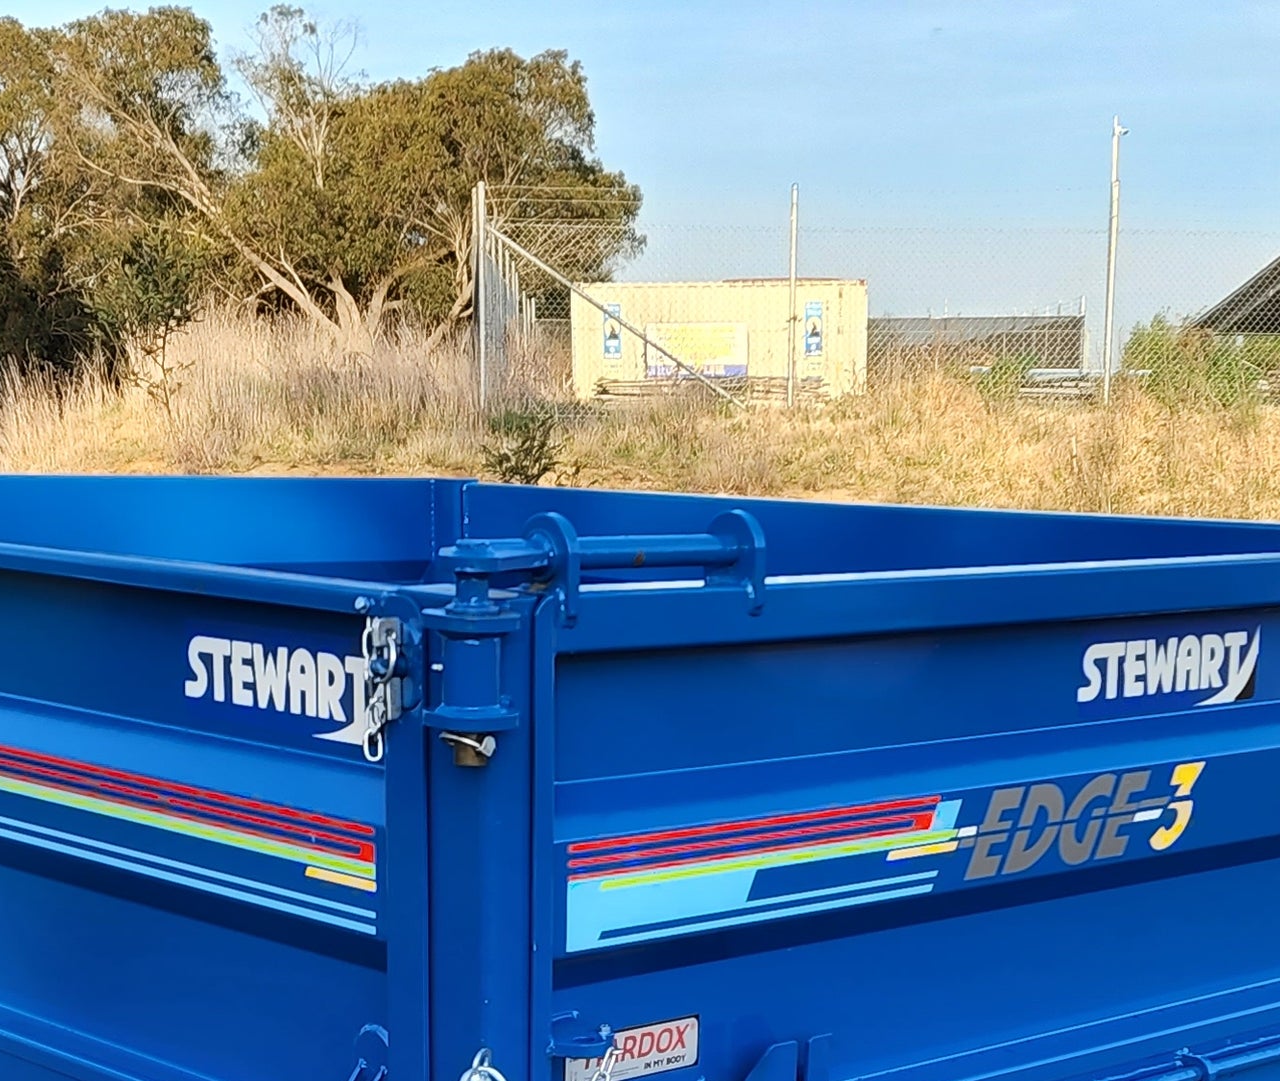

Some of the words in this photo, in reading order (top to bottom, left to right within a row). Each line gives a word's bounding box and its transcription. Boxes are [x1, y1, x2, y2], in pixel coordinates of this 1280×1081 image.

[184, 635, 368, 746] STEWART
[1076, 625, 1261, 706] STEWART
[963, 760, 1206, 881] EDGE-3
[653, 1057, 665, 1068] MY
